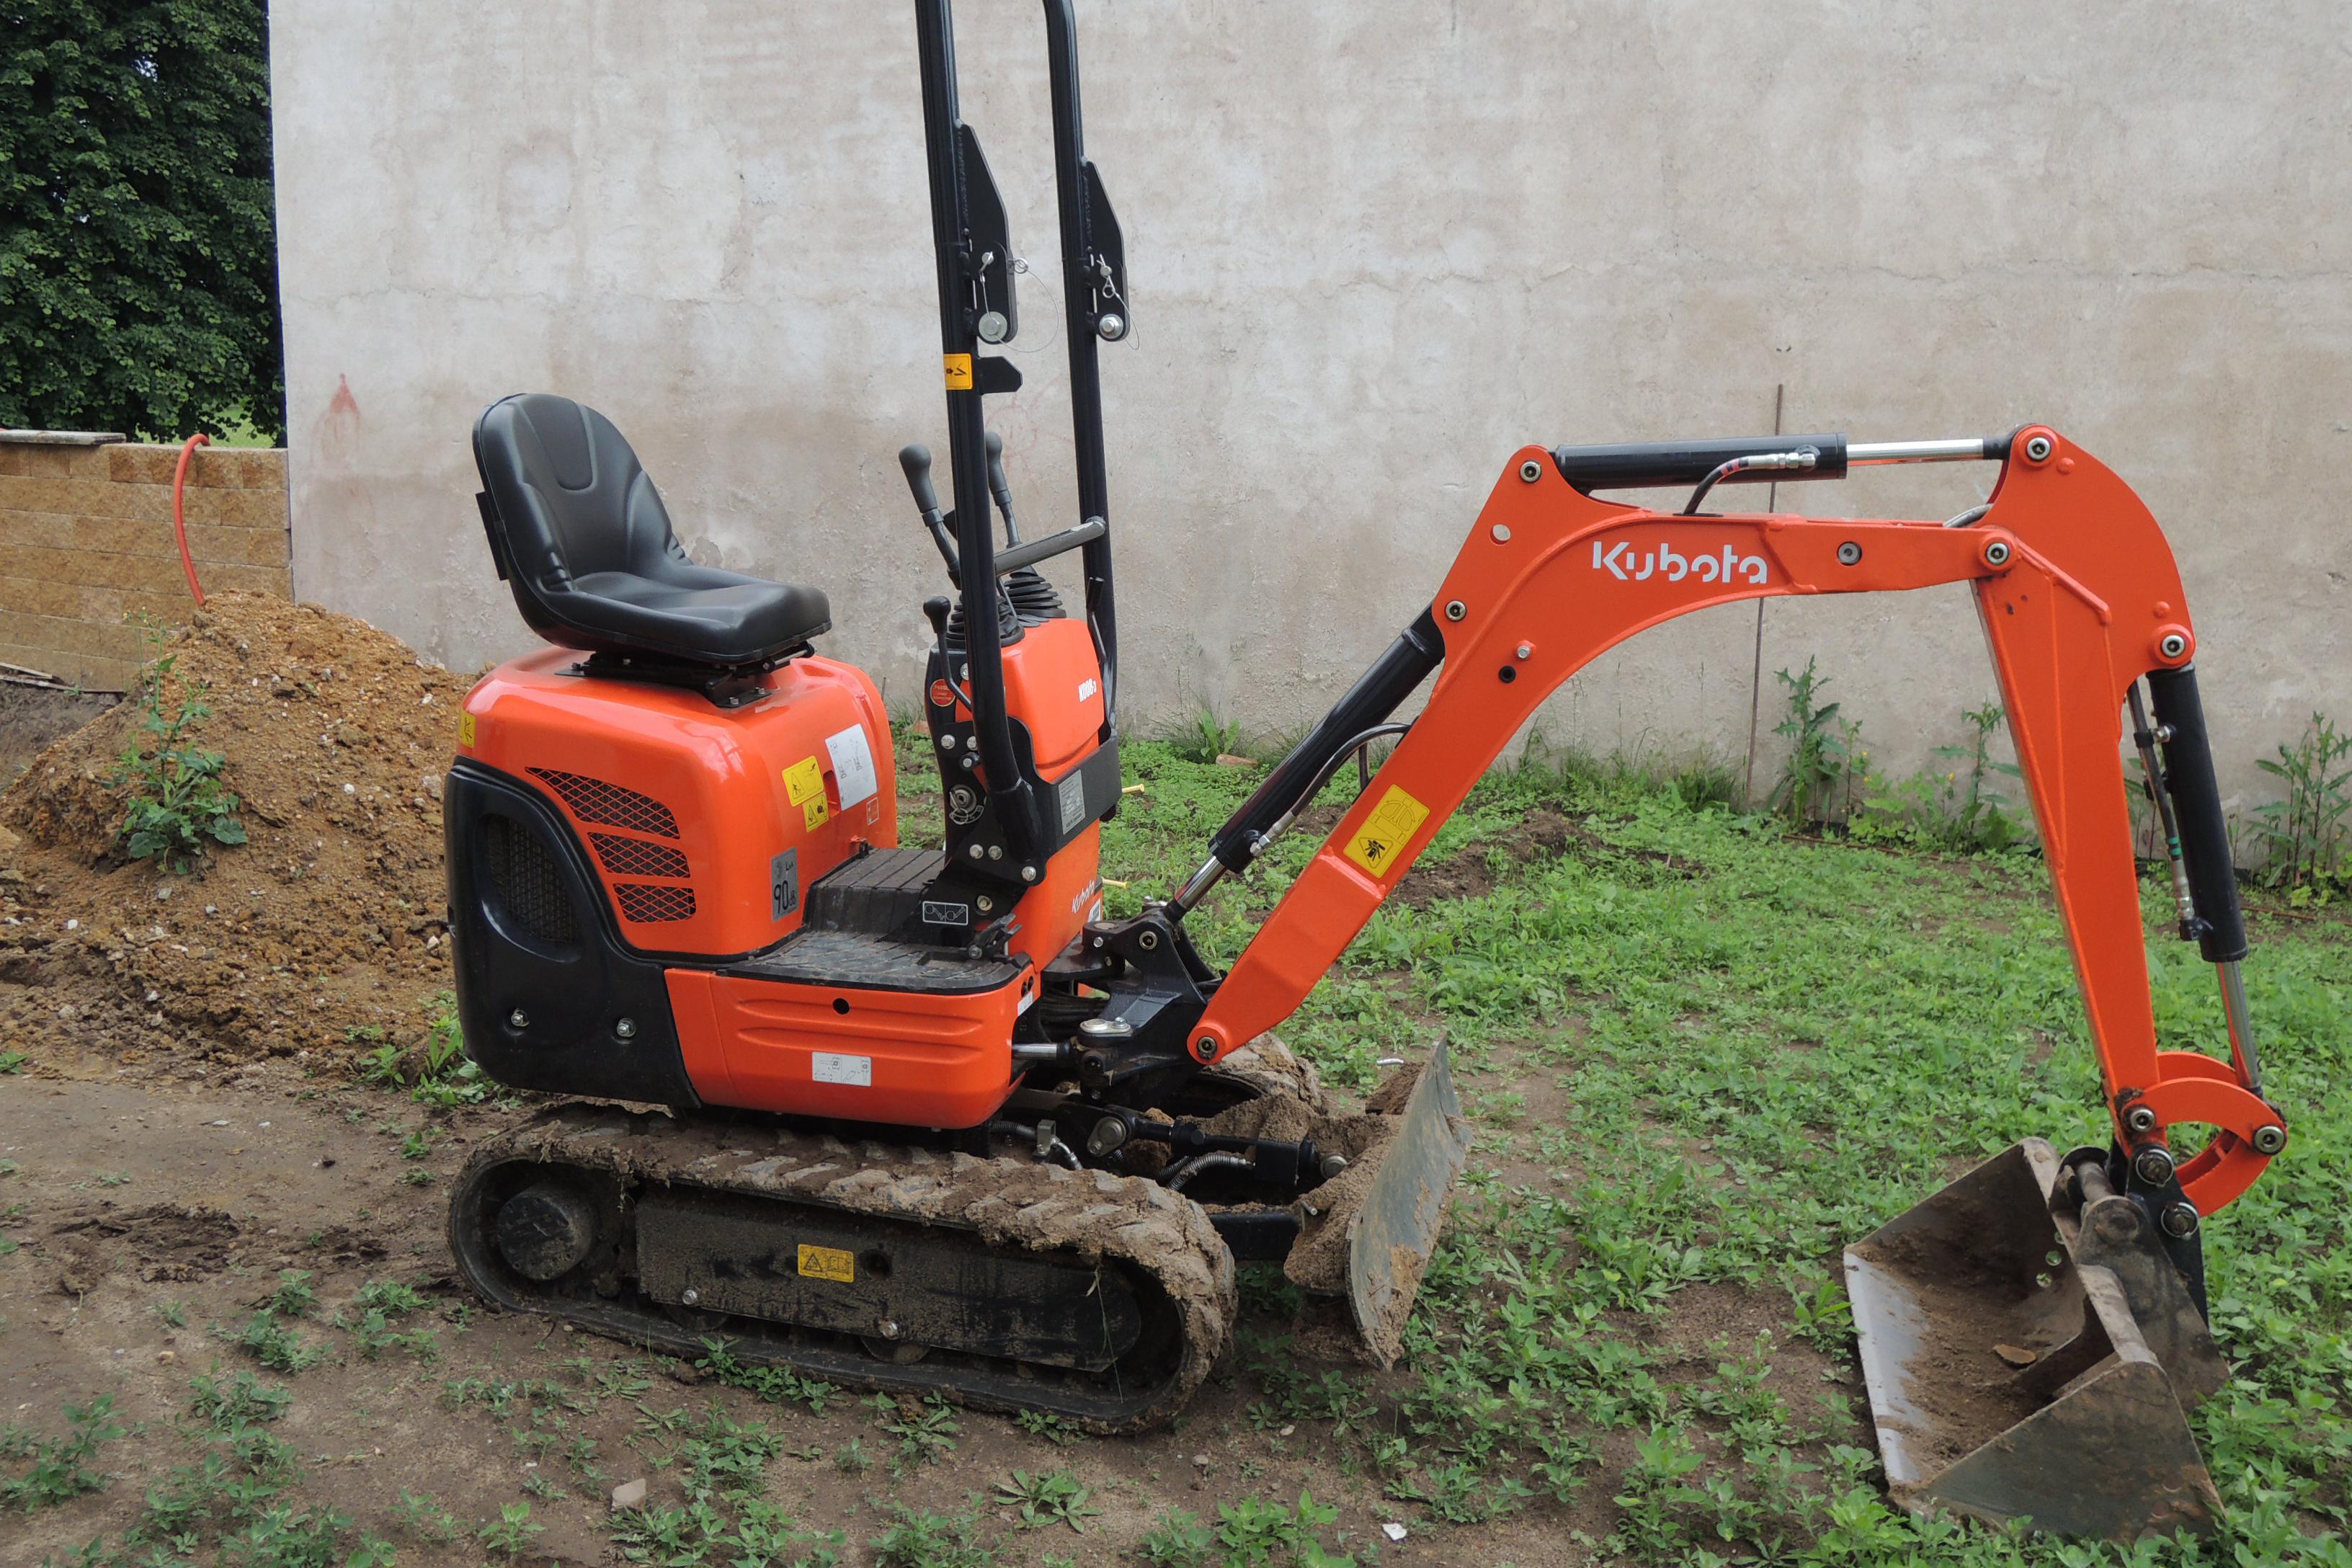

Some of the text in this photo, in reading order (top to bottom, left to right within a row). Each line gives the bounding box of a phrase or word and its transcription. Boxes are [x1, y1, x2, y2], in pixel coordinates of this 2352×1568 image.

[1592, 540, 1768, 584] Kubota
[774, 880, 788, 914] 90
[1072, 879, 1095, 914] Kubota
